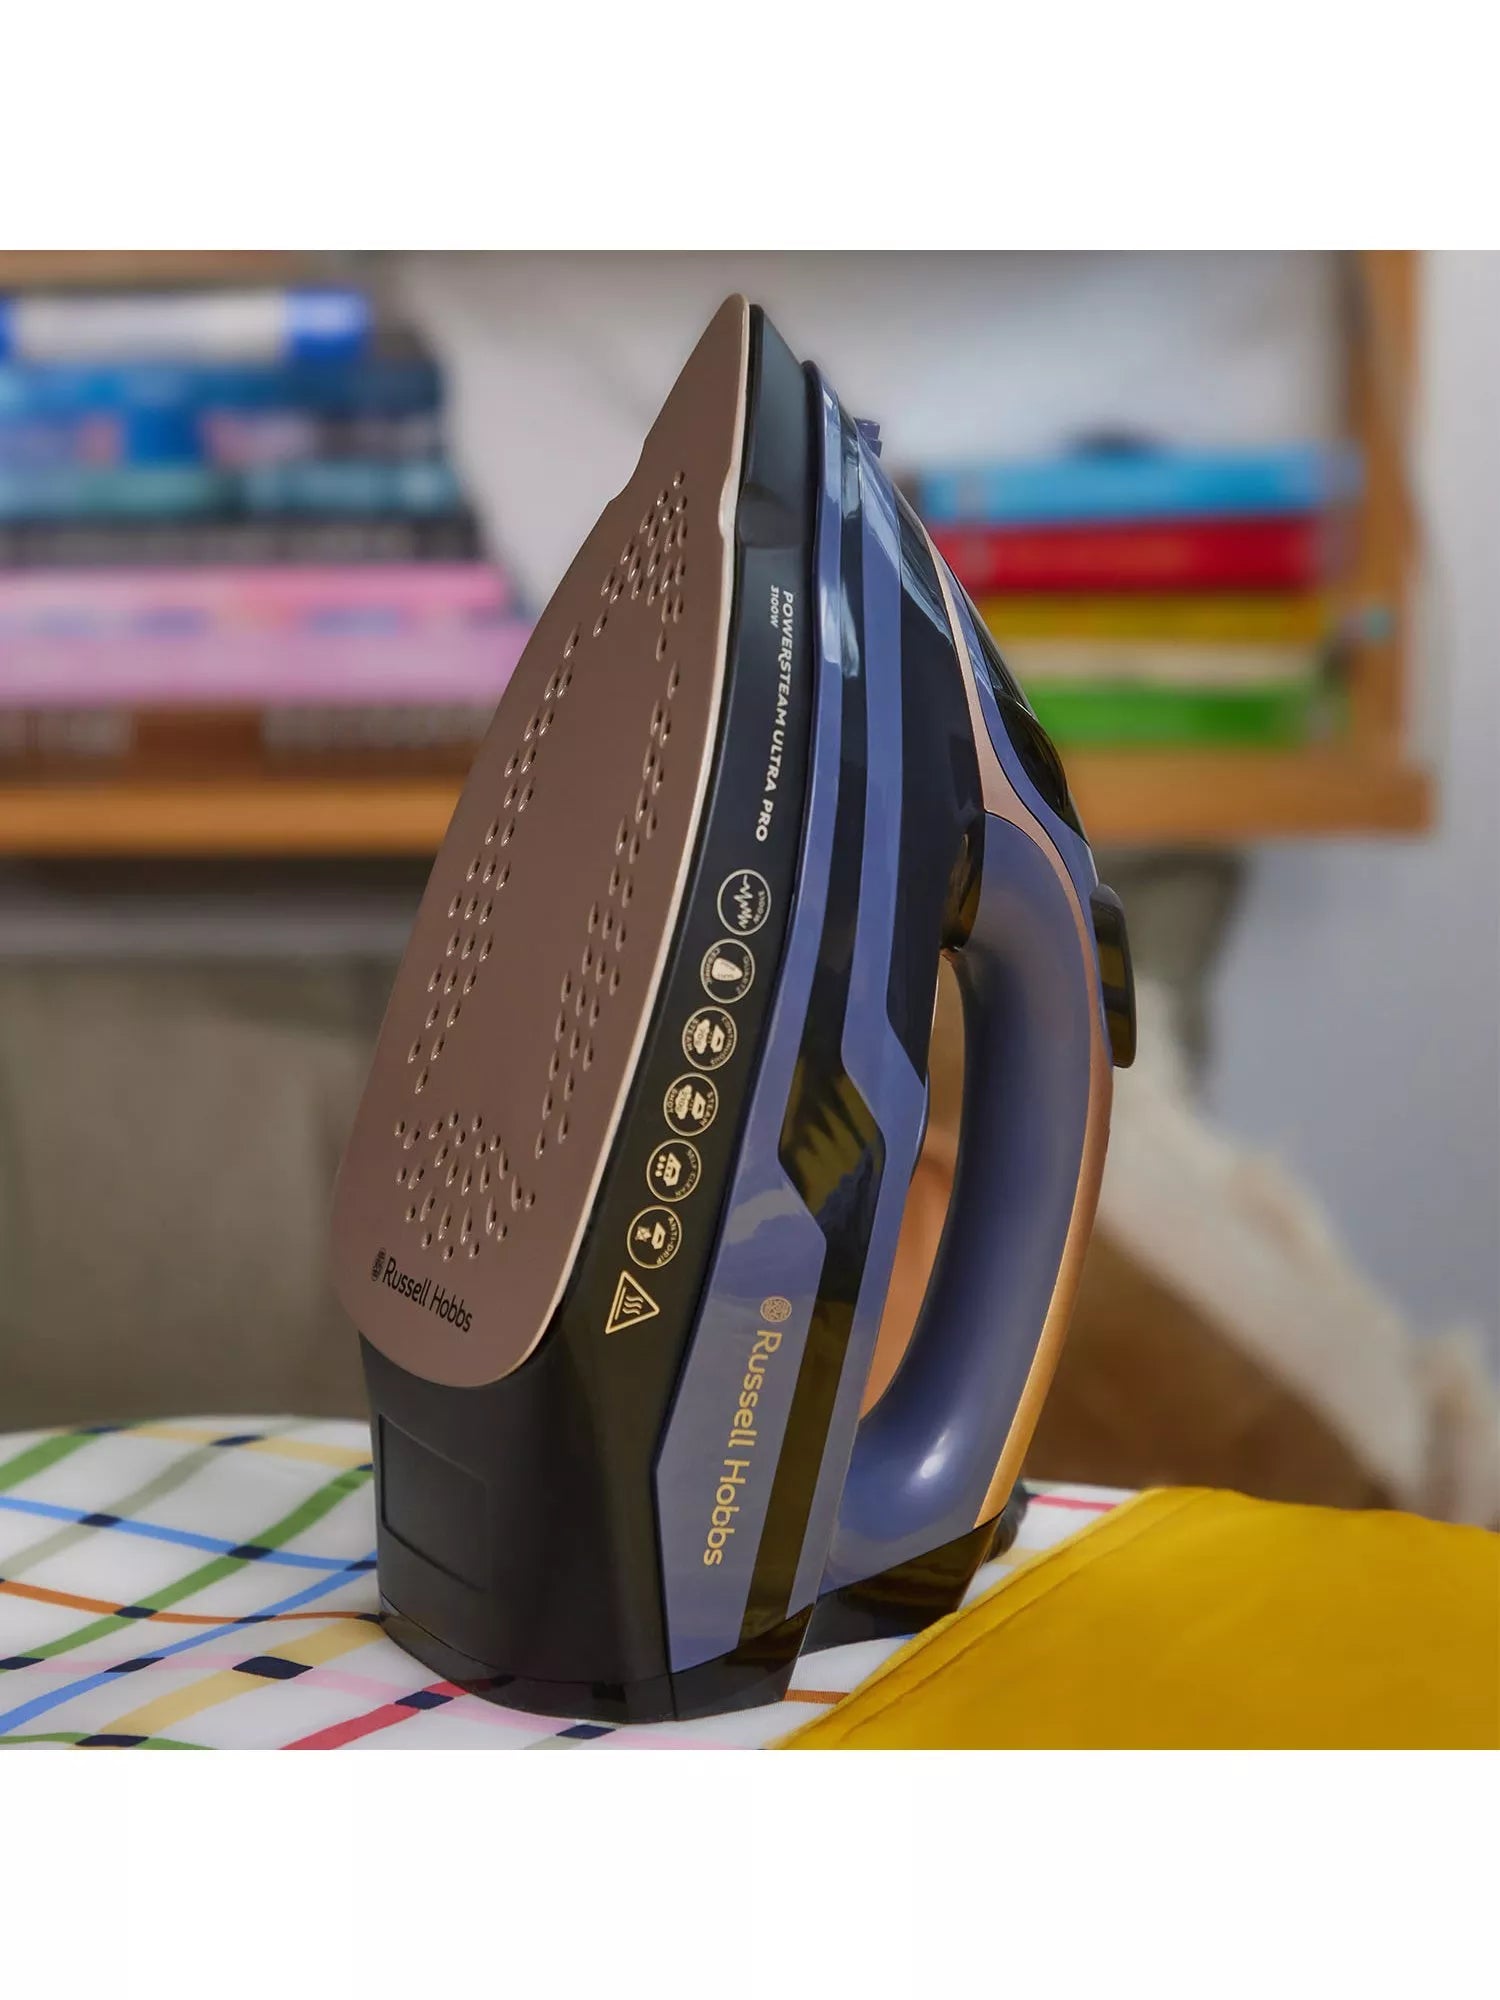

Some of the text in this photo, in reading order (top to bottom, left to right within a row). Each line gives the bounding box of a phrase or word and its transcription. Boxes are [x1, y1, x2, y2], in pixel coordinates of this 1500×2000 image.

[770, 584, 780, 629] 3100W
[755, 590, 794, 842] POWERSTEAM ULTRA PRO
[666, 1088, 678, 1114] SHOT
[700, 1091, 714, 1126] STEAM
[656, 1216, 678, 1265] ANTI-DRIP
[382, 1256, 473, 1333] Russell Hobbs
[703, 1330, 783, 1567] Russell Hobbs
